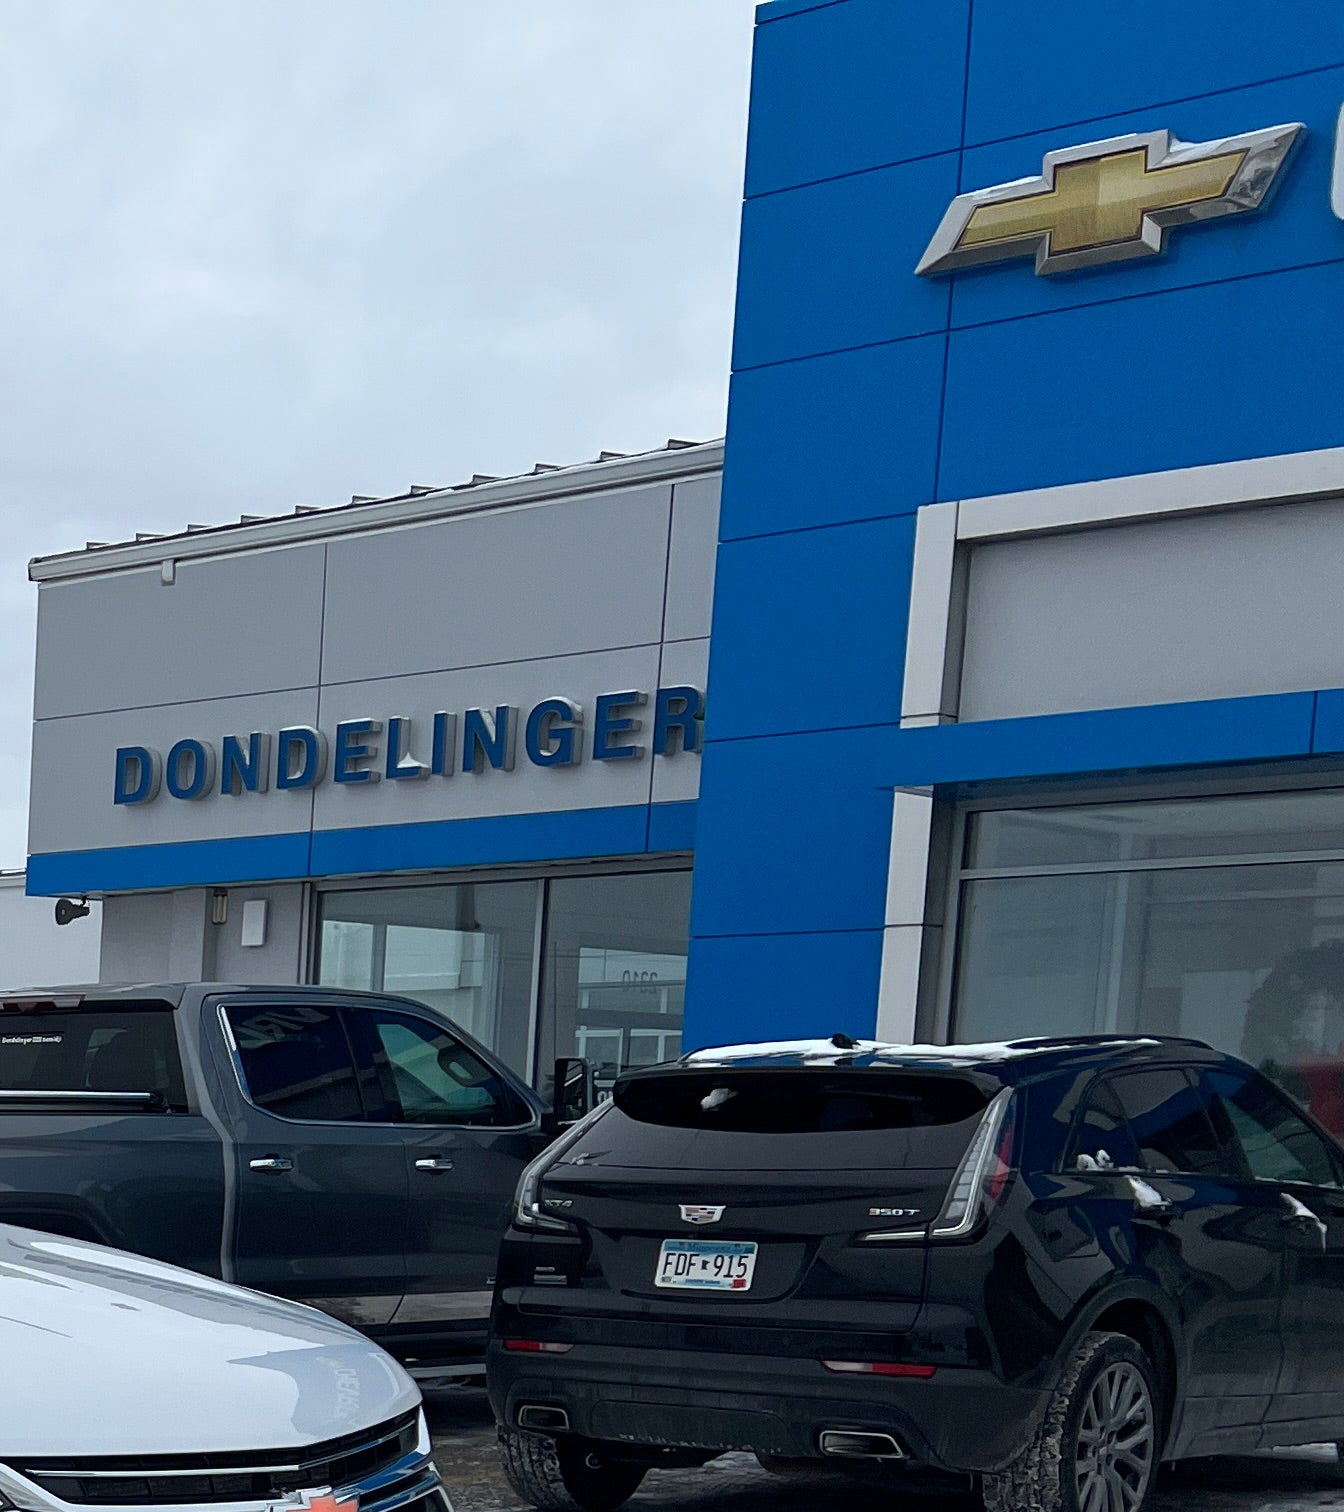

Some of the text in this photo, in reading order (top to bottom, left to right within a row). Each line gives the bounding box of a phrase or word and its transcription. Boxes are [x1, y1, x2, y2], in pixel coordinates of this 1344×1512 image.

[113, 684, 704, 806] DONDELINGER
[662, 1253, 749, 1279] FDF 915
